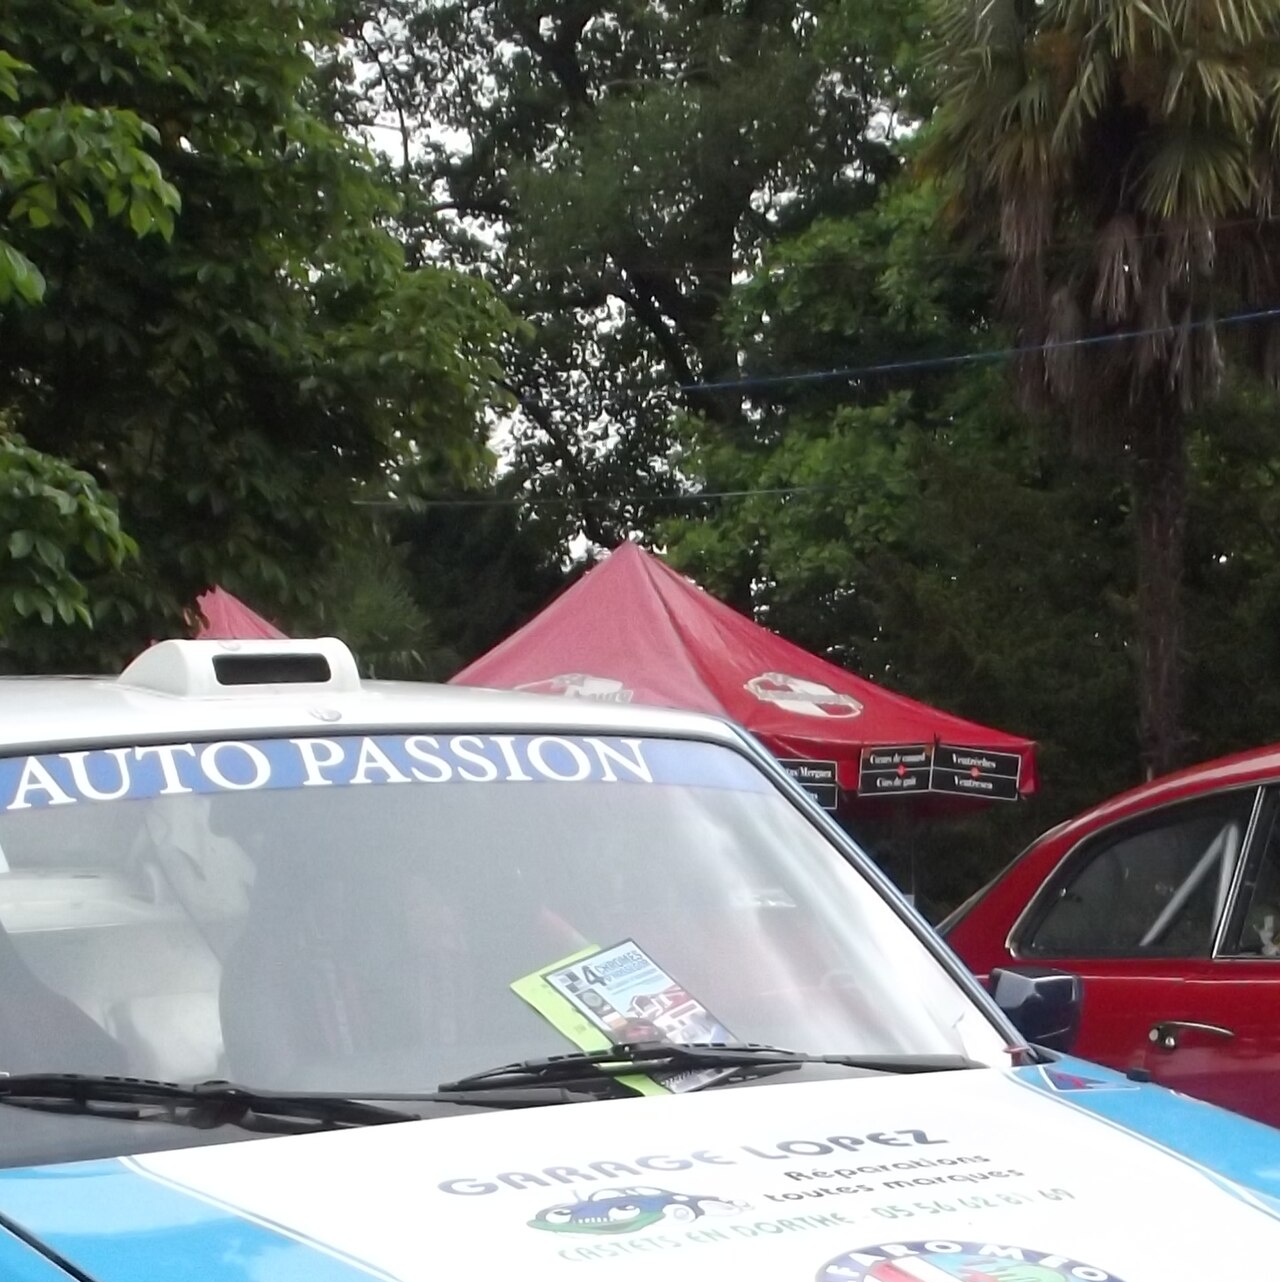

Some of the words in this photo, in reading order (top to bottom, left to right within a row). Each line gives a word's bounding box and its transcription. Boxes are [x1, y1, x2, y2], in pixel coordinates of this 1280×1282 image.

[8, 741, 272, 809] AUTO
[290, 735, 654, 787] PASSION
[437, 1149, 738, 1196] GARAGE
[739, 1129, 951, 1160] LOPEZ
[783, 1153, 992, 1182] Réparations
[763, 1182, 875, 1203] toutes
[882, 1167, 1026, 1189] marques
[879, 1240, 1109, 1281] ROMEO
